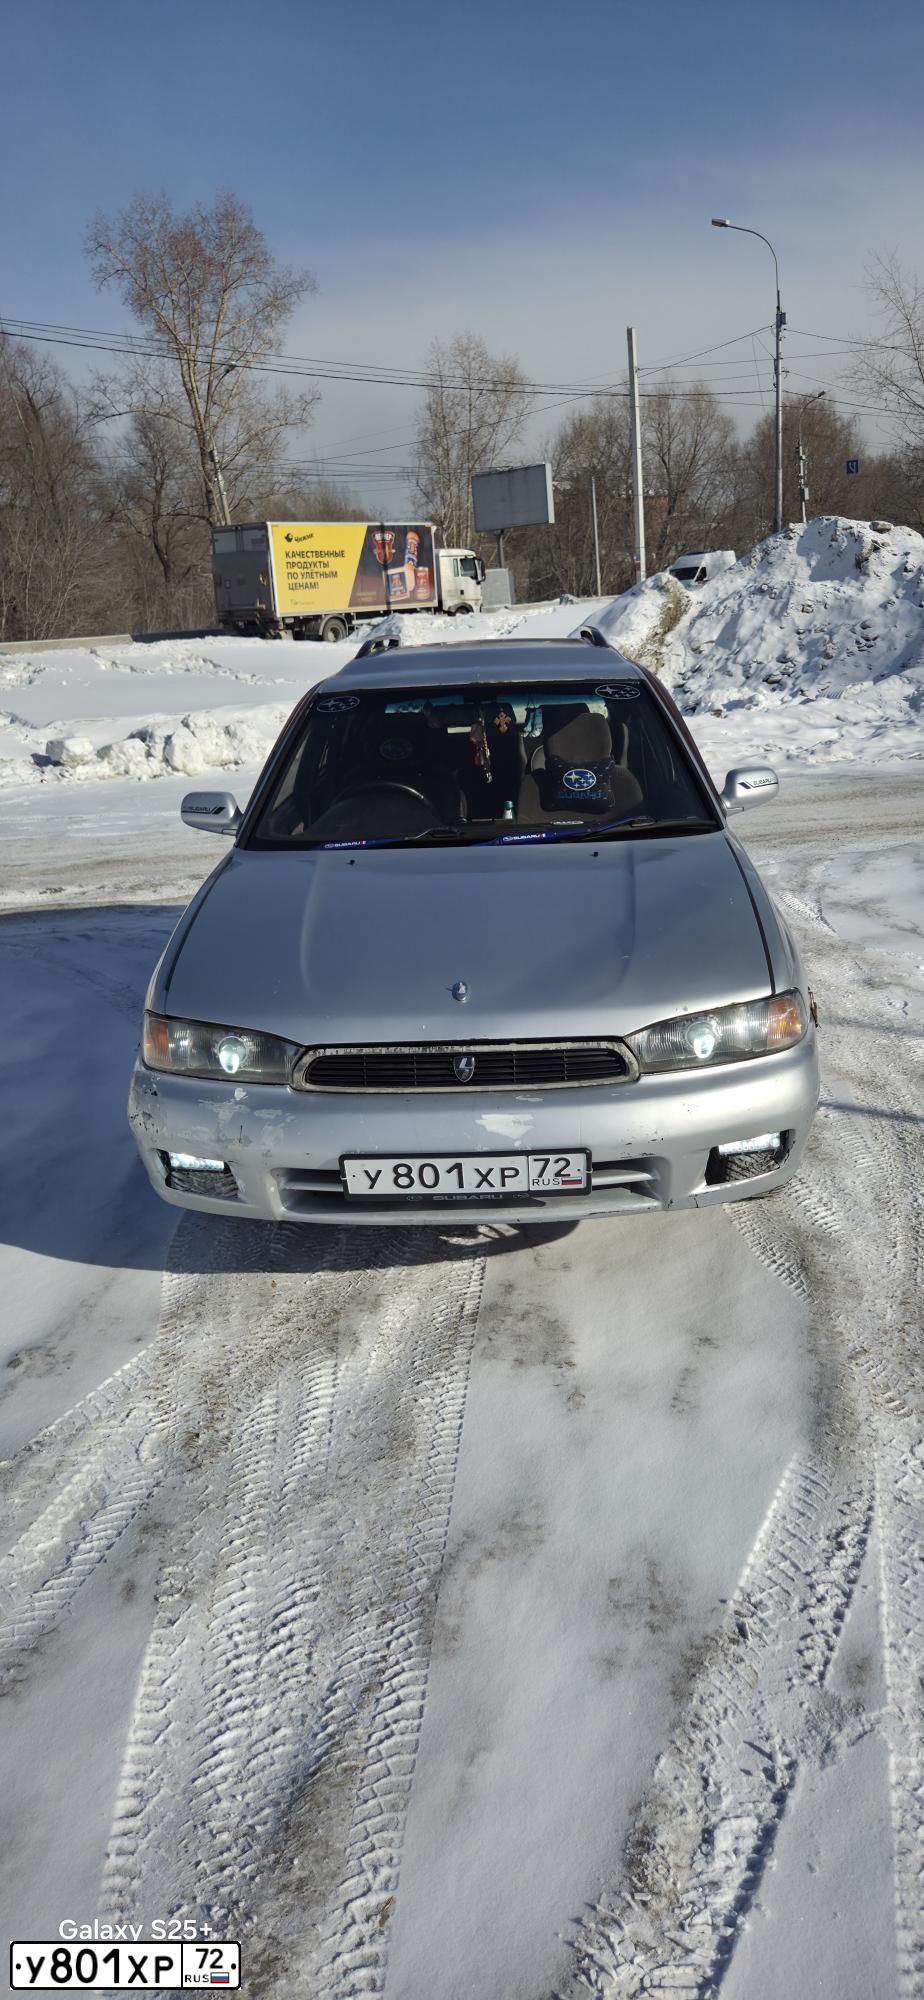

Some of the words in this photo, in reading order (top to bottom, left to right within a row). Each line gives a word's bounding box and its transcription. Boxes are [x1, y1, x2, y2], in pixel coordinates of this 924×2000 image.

[285, 550, 345, 559] КАЧЕСТВЕННЫЕ
[286, 561, 330, 570] ПРОДУКТЫ
[287, 571, 299, 580] ПО
[288, 581, 320, 592] ЦЕНАМ!
[532, 1157, 571, 1178] 72
[531, 1177, 561, 1187] RUS
[432, 1193, 503, 1201] SUBARU
